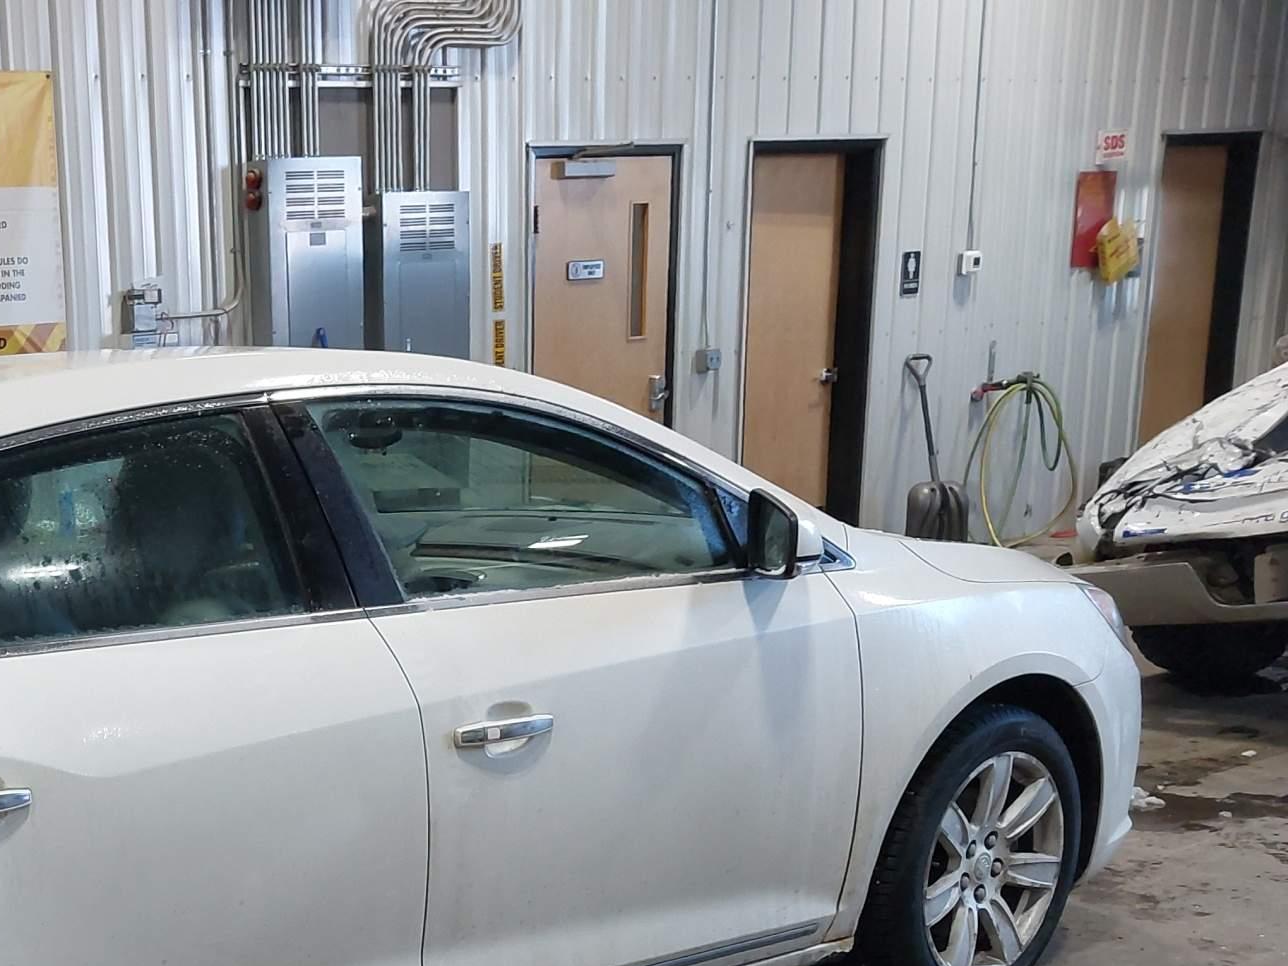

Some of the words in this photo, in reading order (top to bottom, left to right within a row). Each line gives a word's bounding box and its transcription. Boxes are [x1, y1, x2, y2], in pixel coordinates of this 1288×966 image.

[1104, 134, 1125, 151] SDS
[17, 256, 29, 265] DO
[1, 270, 10, 278] IN
[12, 269, 25, 277] THE
